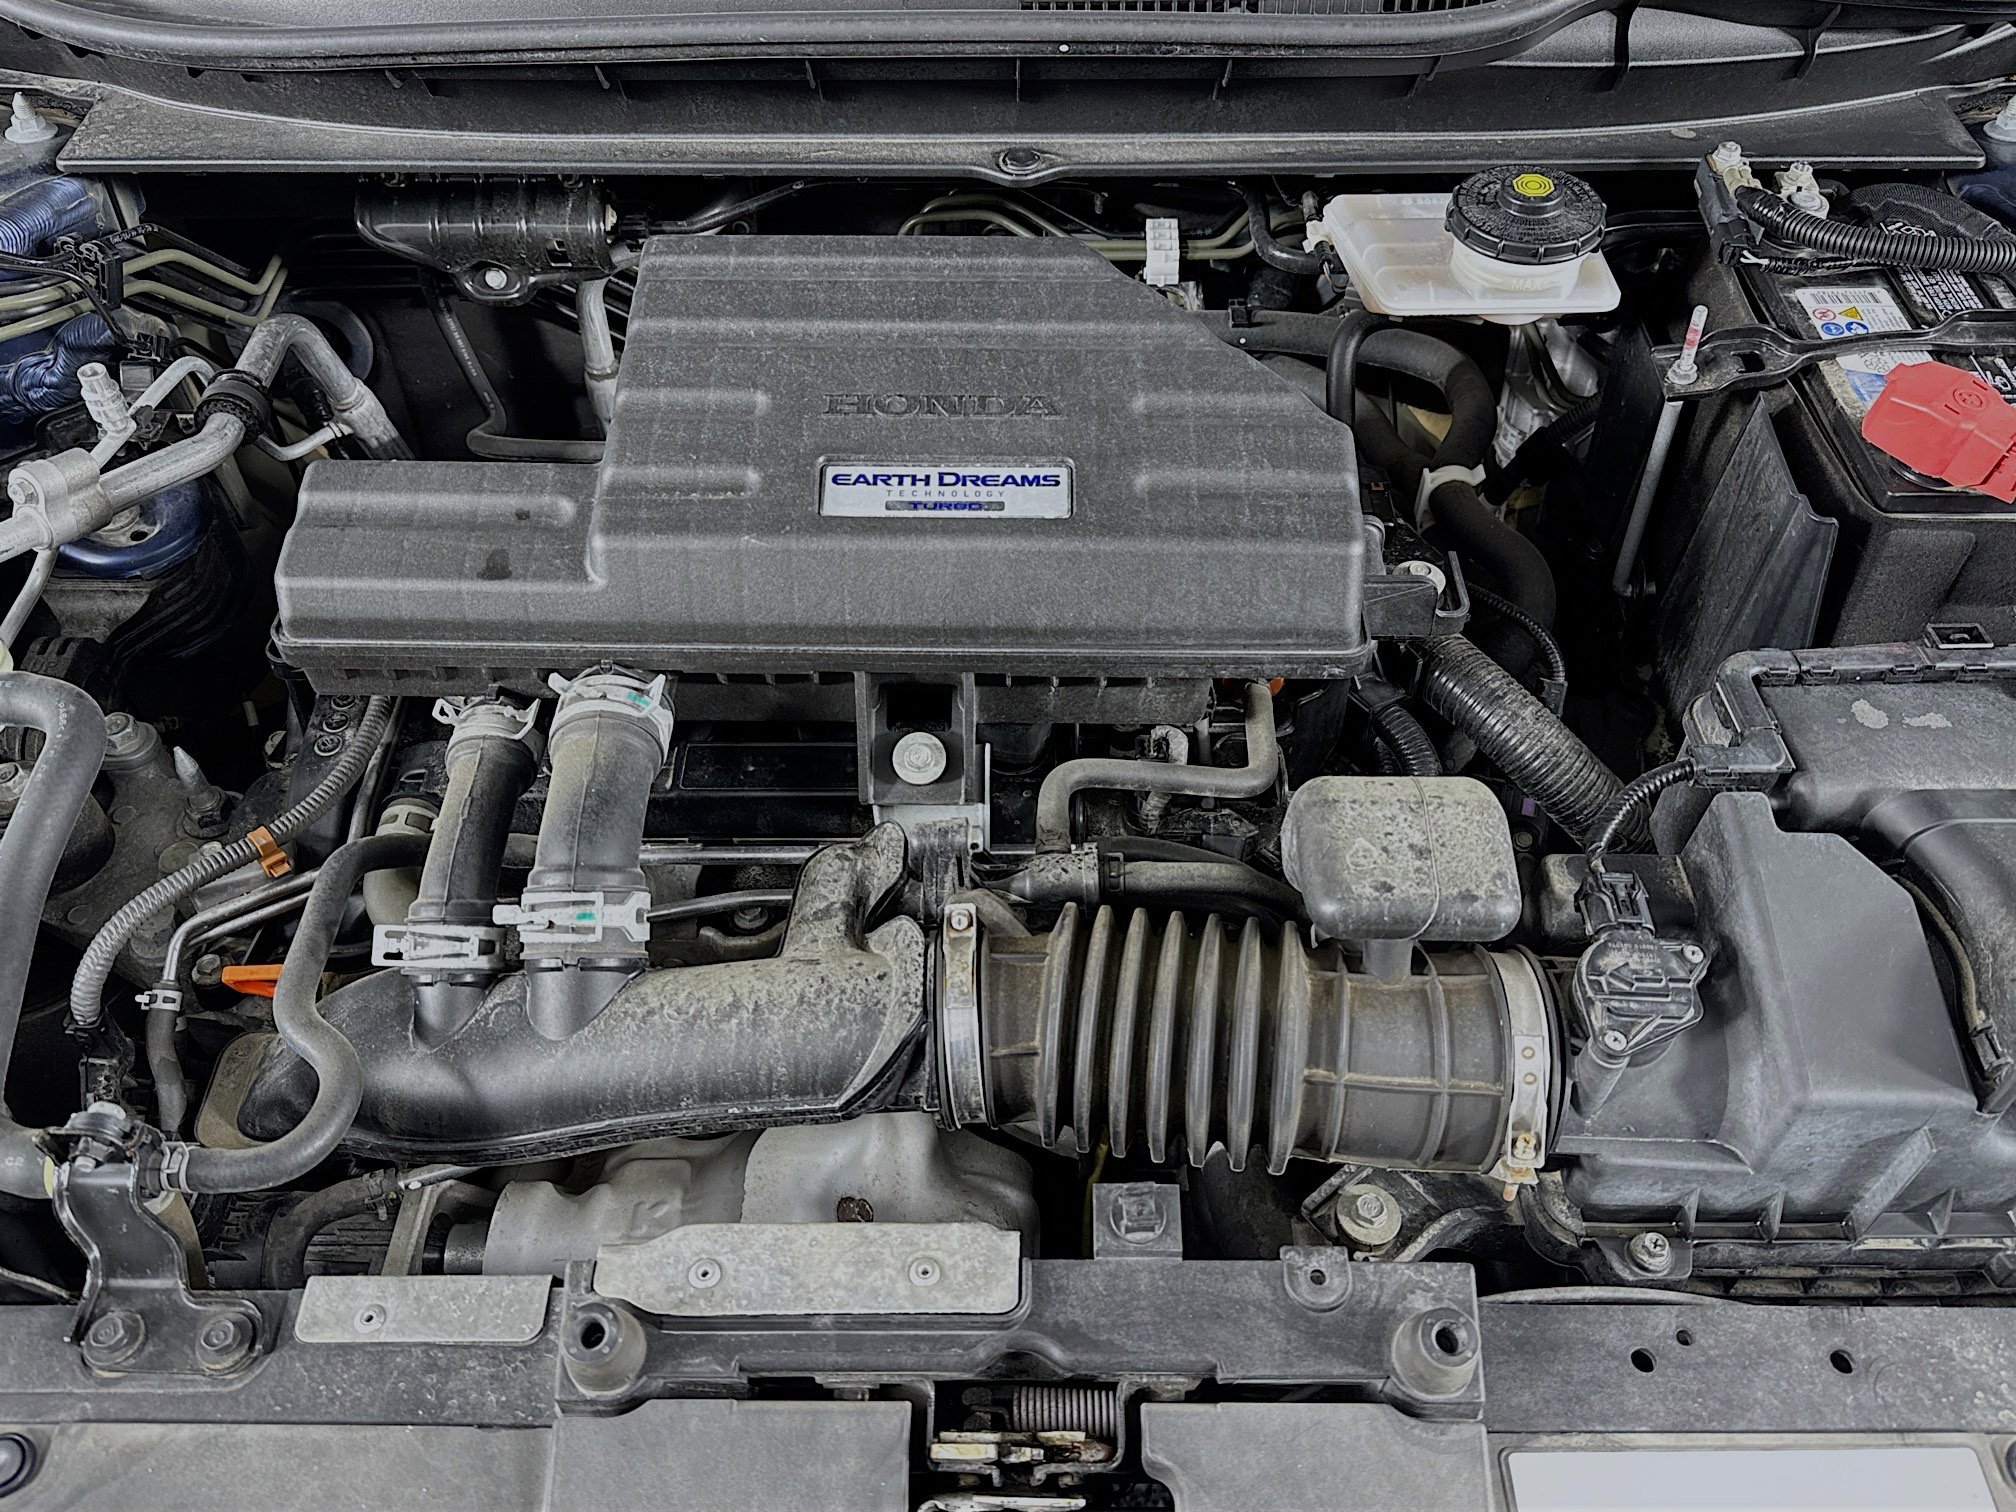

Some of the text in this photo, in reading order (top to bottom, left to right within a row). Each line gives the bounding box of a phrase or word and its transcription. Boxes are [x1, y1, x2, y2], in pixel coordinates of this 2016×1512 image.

[821, 394, 1068, 418] HONDA
[831, 472, 1061, 487] EARTH DREAMS
[886, 489, 1005, 498] TECHNOLOGY
[908, 501, 983, 512] TURBO
